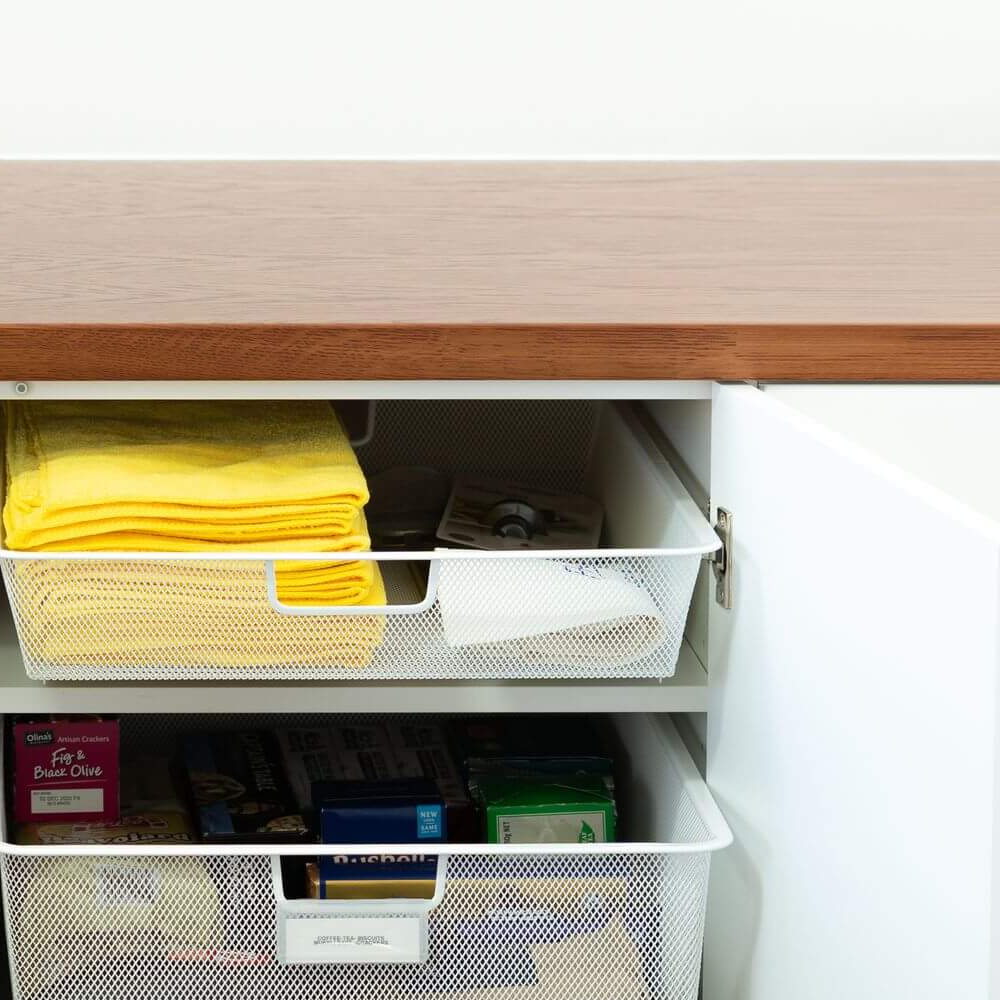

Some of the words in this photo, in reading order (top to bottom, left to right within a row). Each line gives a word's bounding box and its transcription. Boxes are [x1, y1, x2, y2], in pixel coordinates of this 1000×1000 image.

[26, 732, 52, 743] Olina's
[57, 735, 81, 743] Artisan
[81, 735, 109, 743] Crackers
[50, 747, 74, 768] Fig
[77, 750, 86, 760] &
[34, 766, 68, 779] Black
[71, 764, 103, 778] Olive
